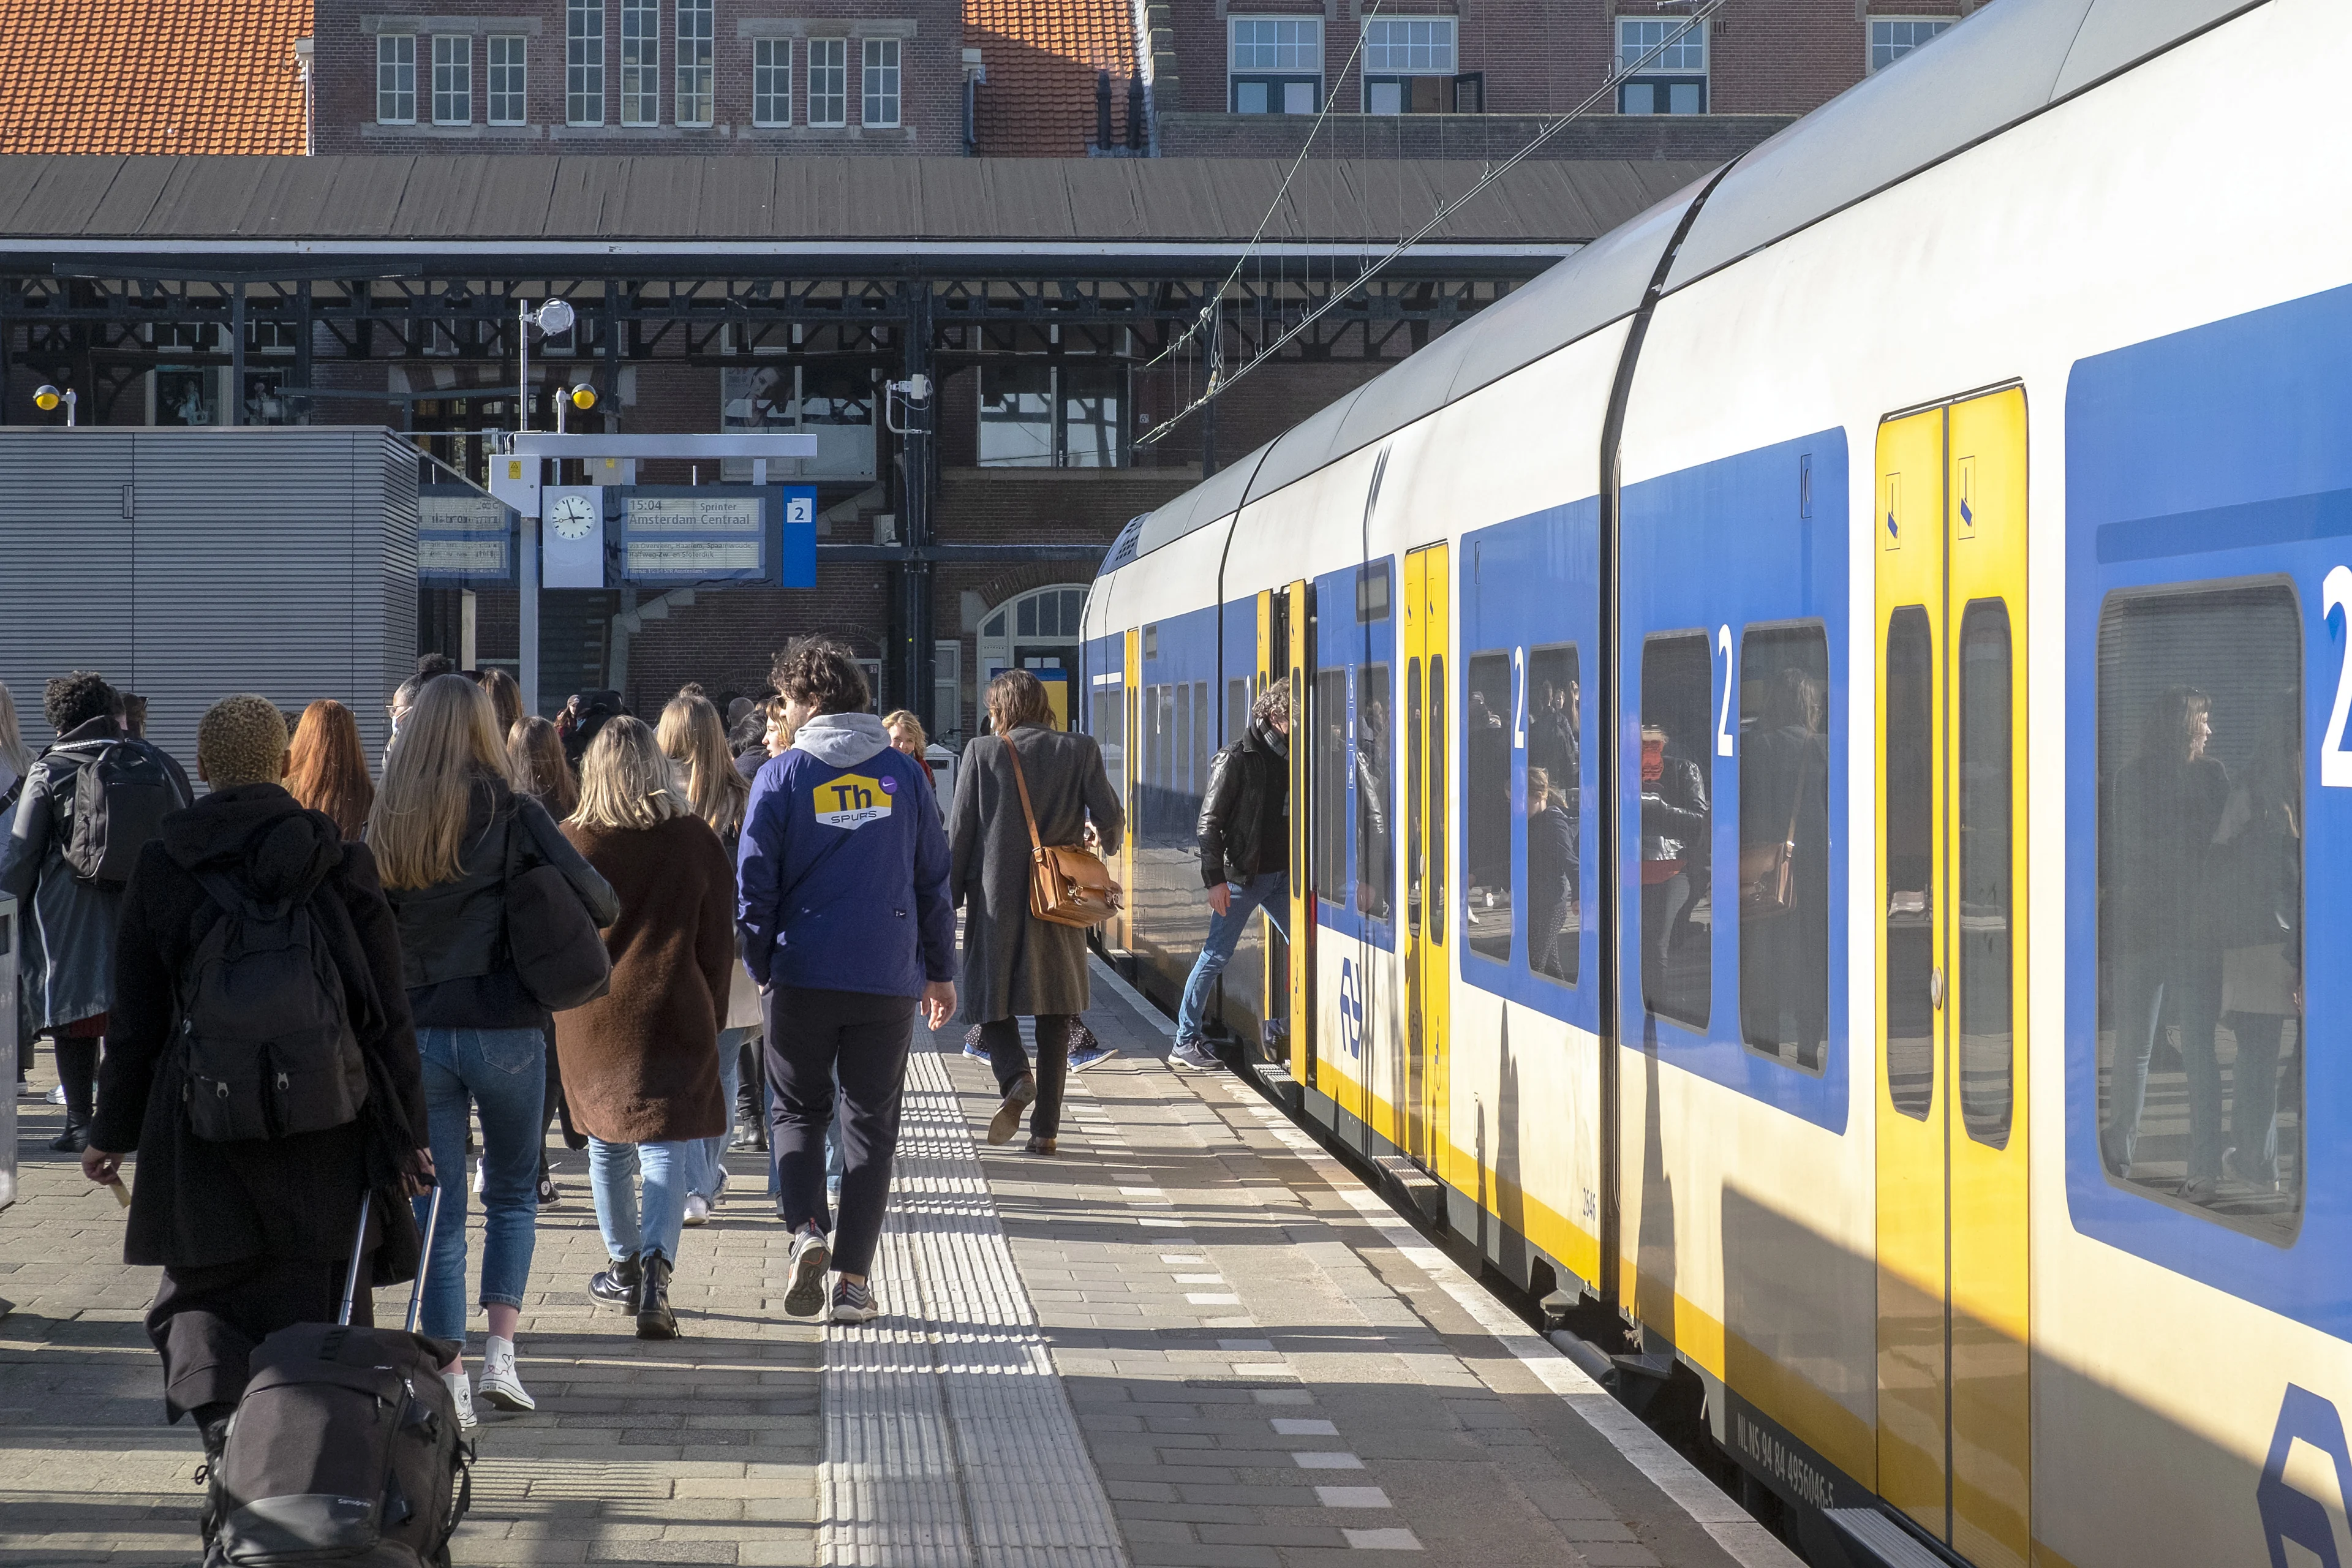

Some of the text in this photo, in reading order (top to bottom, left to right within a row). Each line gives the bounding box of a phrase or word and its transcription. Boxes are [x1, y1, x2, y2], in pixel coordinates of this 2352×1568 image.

[629, 514, 750, 524] Amsterdam Centraal
[630, 500, 736, 513] 15:04 Sprinter
[795, 507, 804, 521] 2
[1717, 624, 1733, 756] 2
[2321, 565, 2352, 787] 2
[1514, 646, 1524, 748] 2
[831, 785, 872, 812] Th
[831, 810, 876, 824] SPURS
[1583, 1187, 1596, 1223] 2646
[1738, 1412, 1747, 1453] NL
[1749, 1421, 1760, 1461] NS
[1762, 1431, 1772, 1471] 94
[1775, 1441, 1785, 1482] 84
